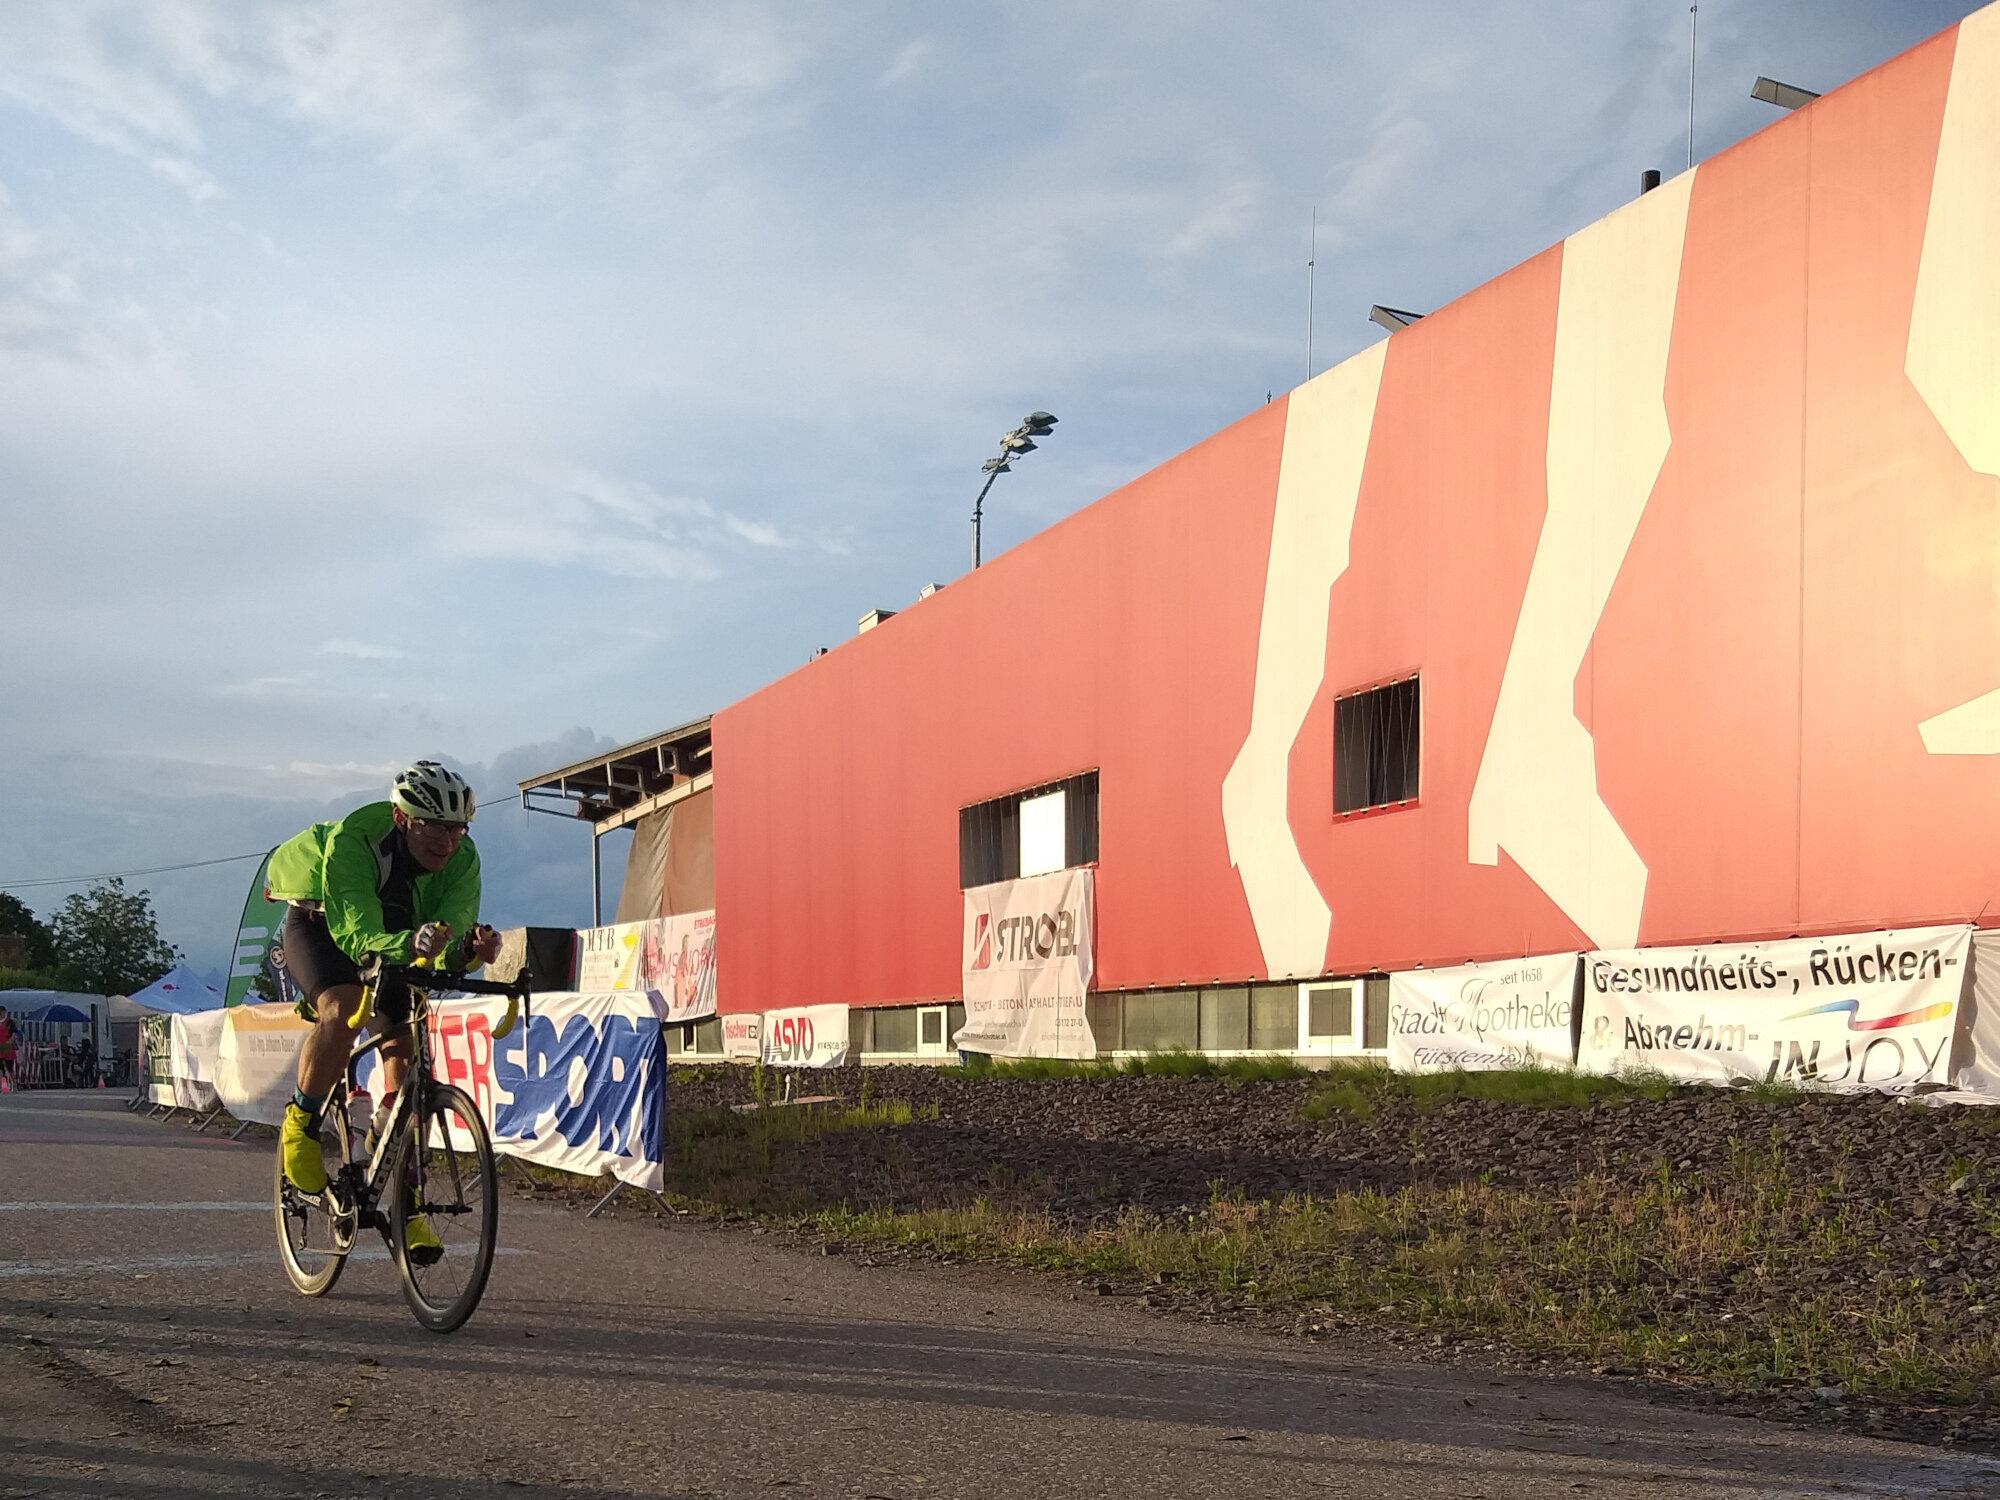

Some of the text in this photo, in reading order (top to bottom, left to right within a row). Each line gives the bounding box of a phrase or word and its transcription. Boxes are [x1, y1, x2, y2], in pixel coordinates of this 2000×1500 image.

[1500, 967, 1543, 985] seit 1658
[1809, 944, 1957, 986] Rücken-
[1764, 1036, 1948, 1084] INJOY
